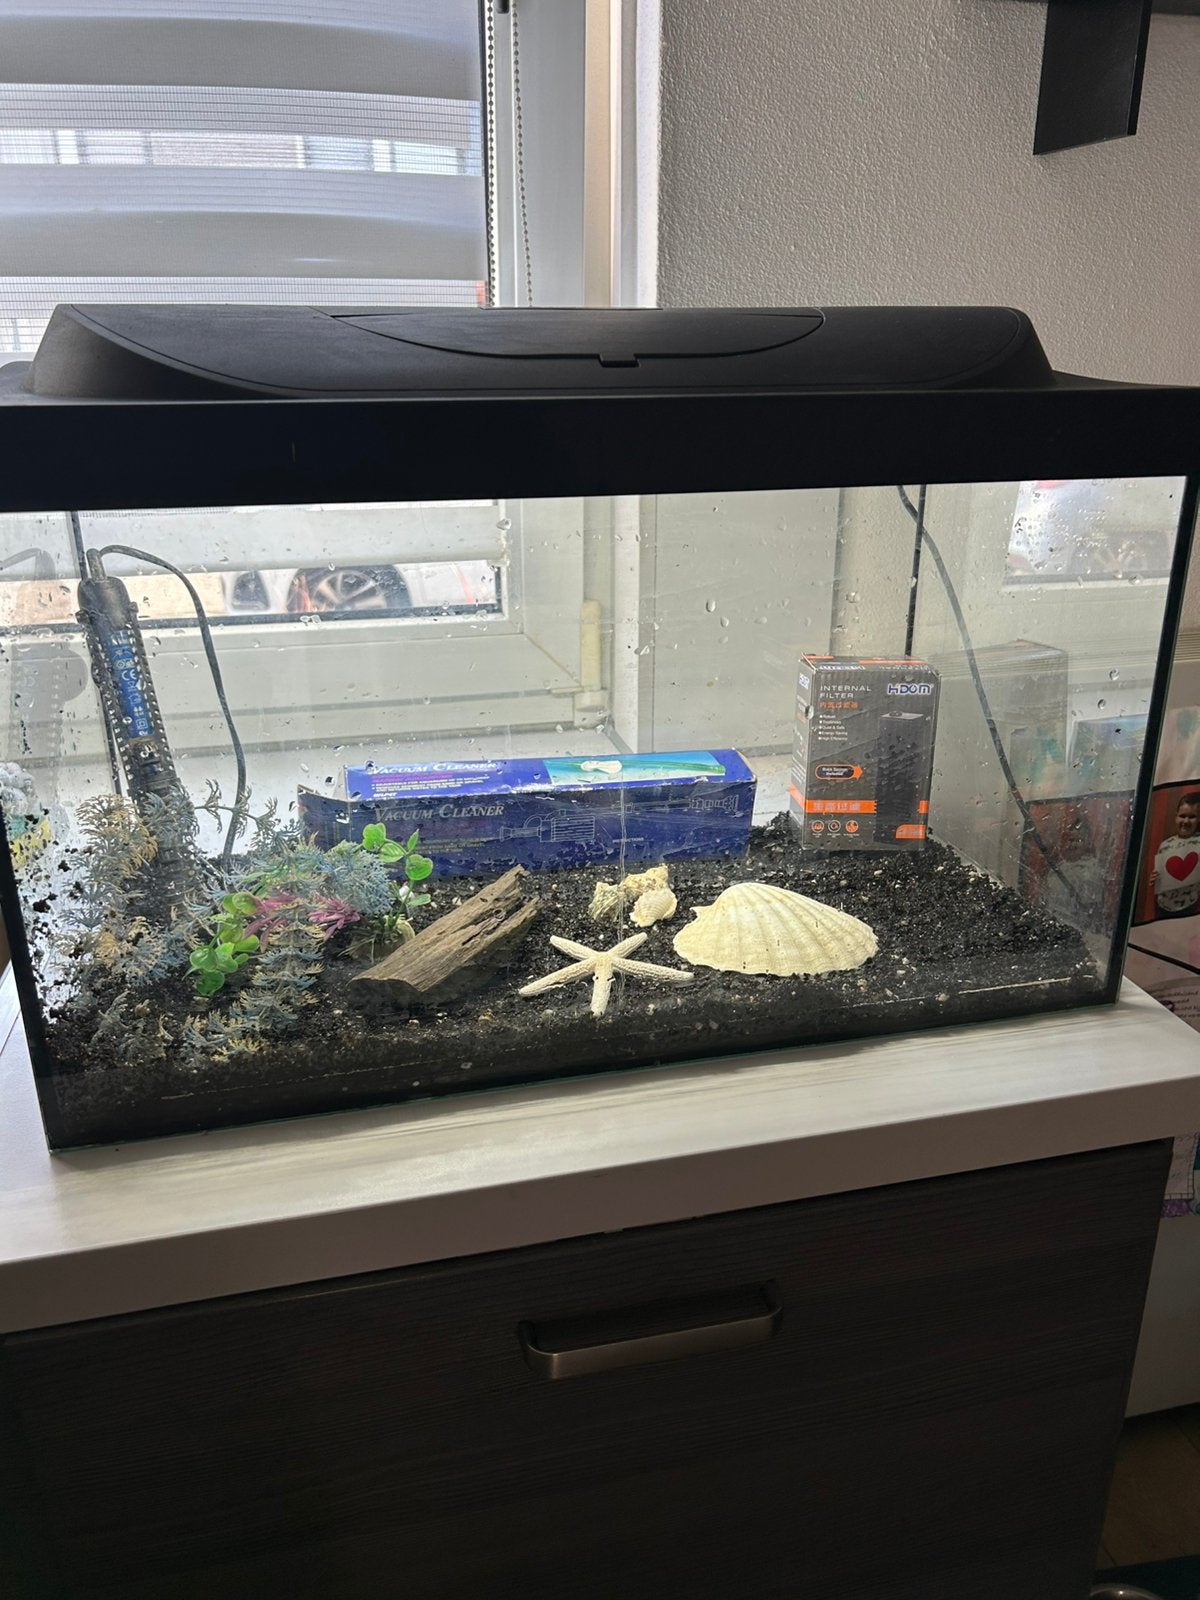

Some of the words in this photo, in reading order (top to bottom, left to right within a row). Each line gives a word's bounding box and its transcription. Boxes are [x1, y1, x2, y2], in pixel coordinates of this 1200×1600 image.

[121, 669, 137, 681] CE
[373, 765, 427, 774] VACUUM
[433, 762, 496, 771] CLEANER
[375, 807, 432, 822] VACUUM
[439, 804, 505, 818] CLEANER
